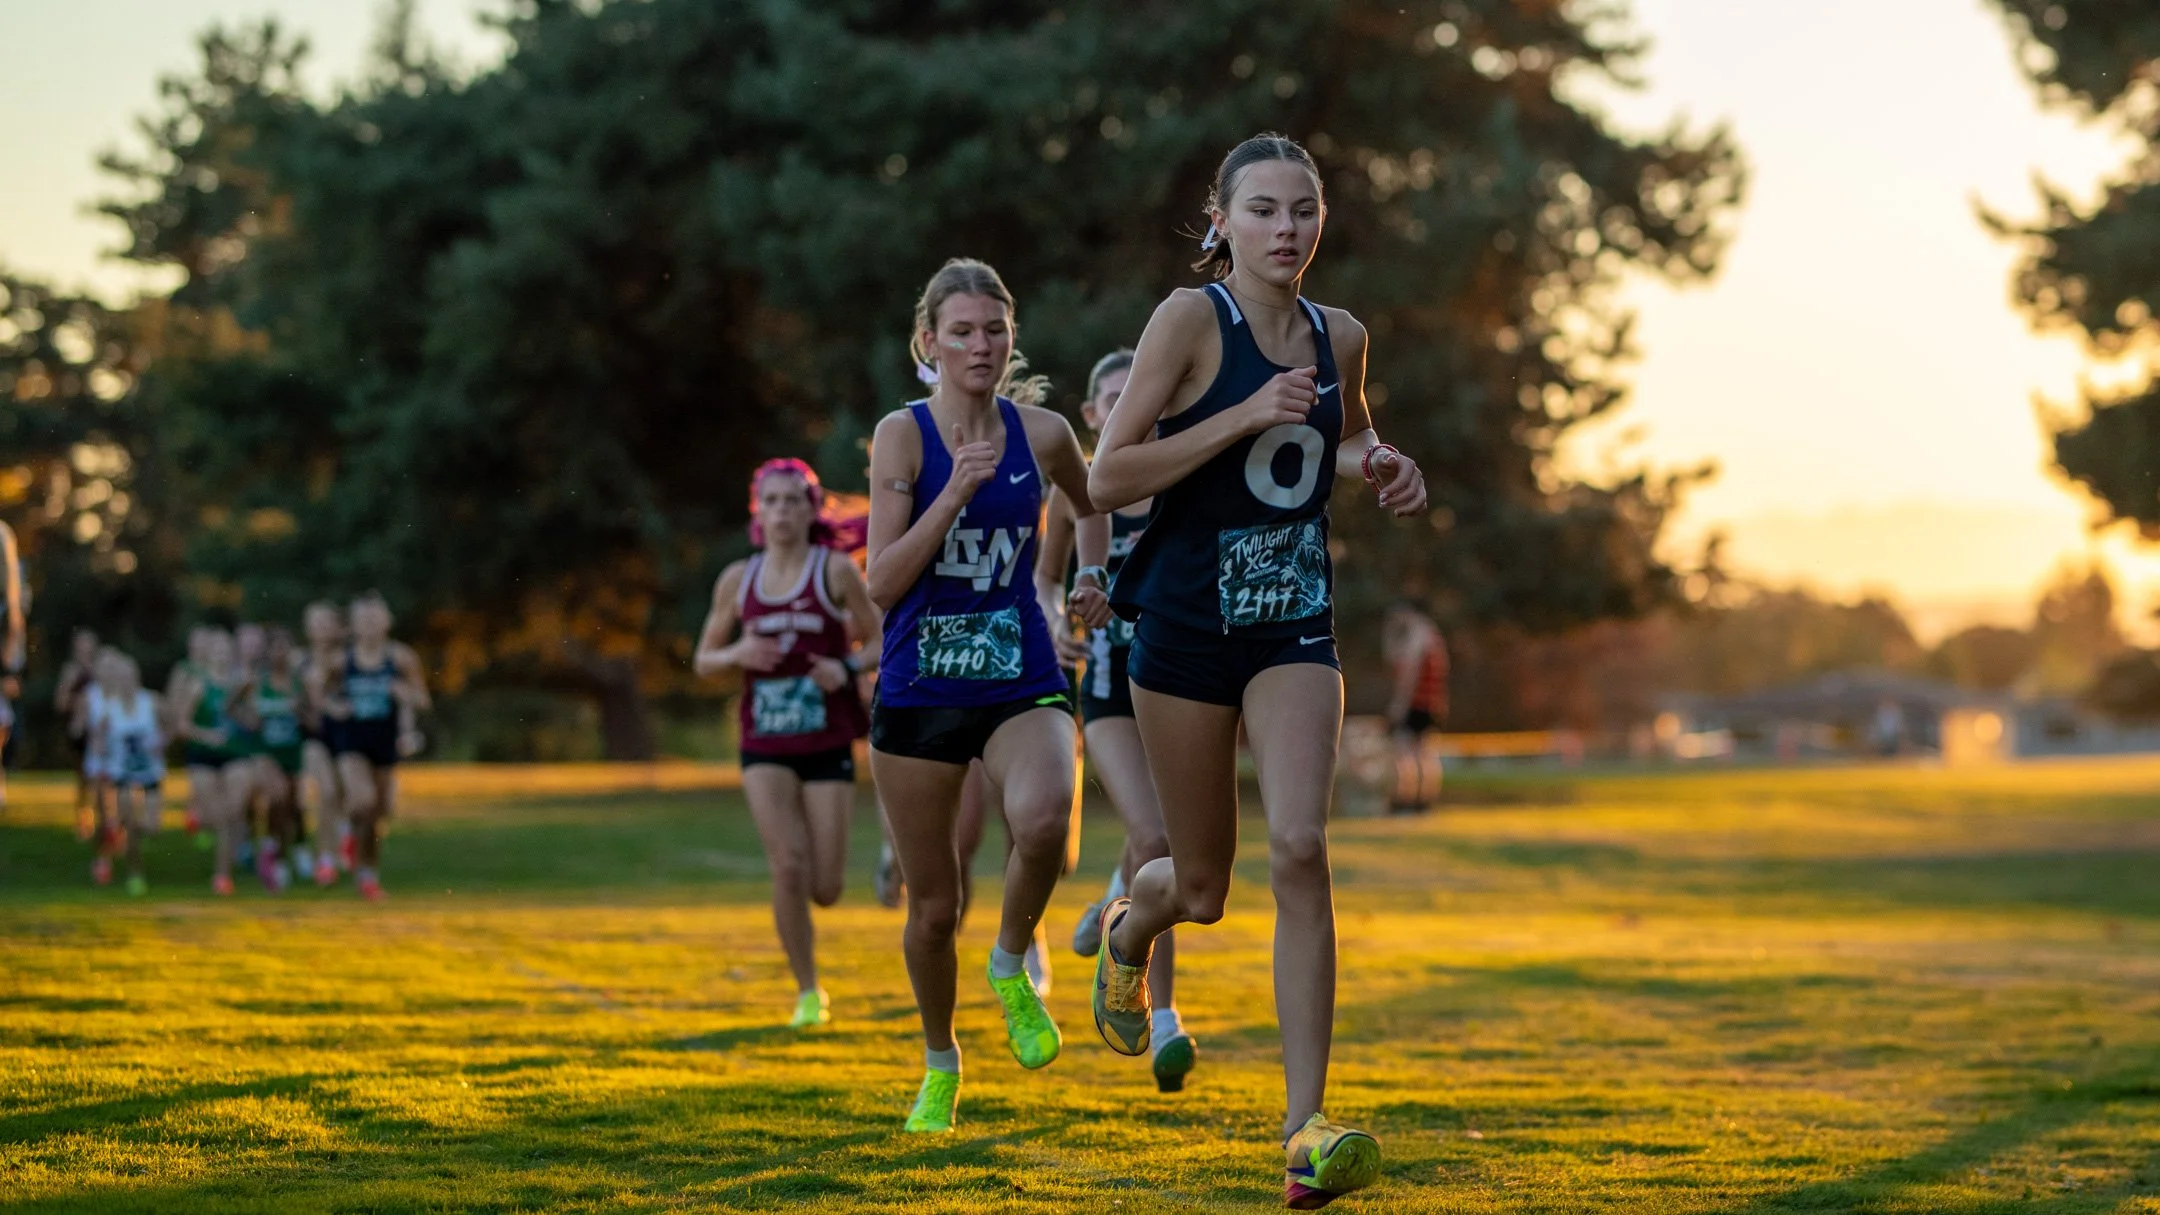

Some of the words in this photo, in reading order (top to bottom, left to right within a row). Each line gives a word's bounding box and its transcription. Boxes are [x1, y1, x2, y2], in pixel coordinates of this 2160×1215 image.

[1244, 423, 1325, 509] O
[1229, 526, 1293, 565] TWILIGHT
[1242, 549, 1275, 576] XC
[1233, 584, 1297, 618] 2147
[938, 619, 967, 638] XC
[930, 648, 985, 676] 1440
